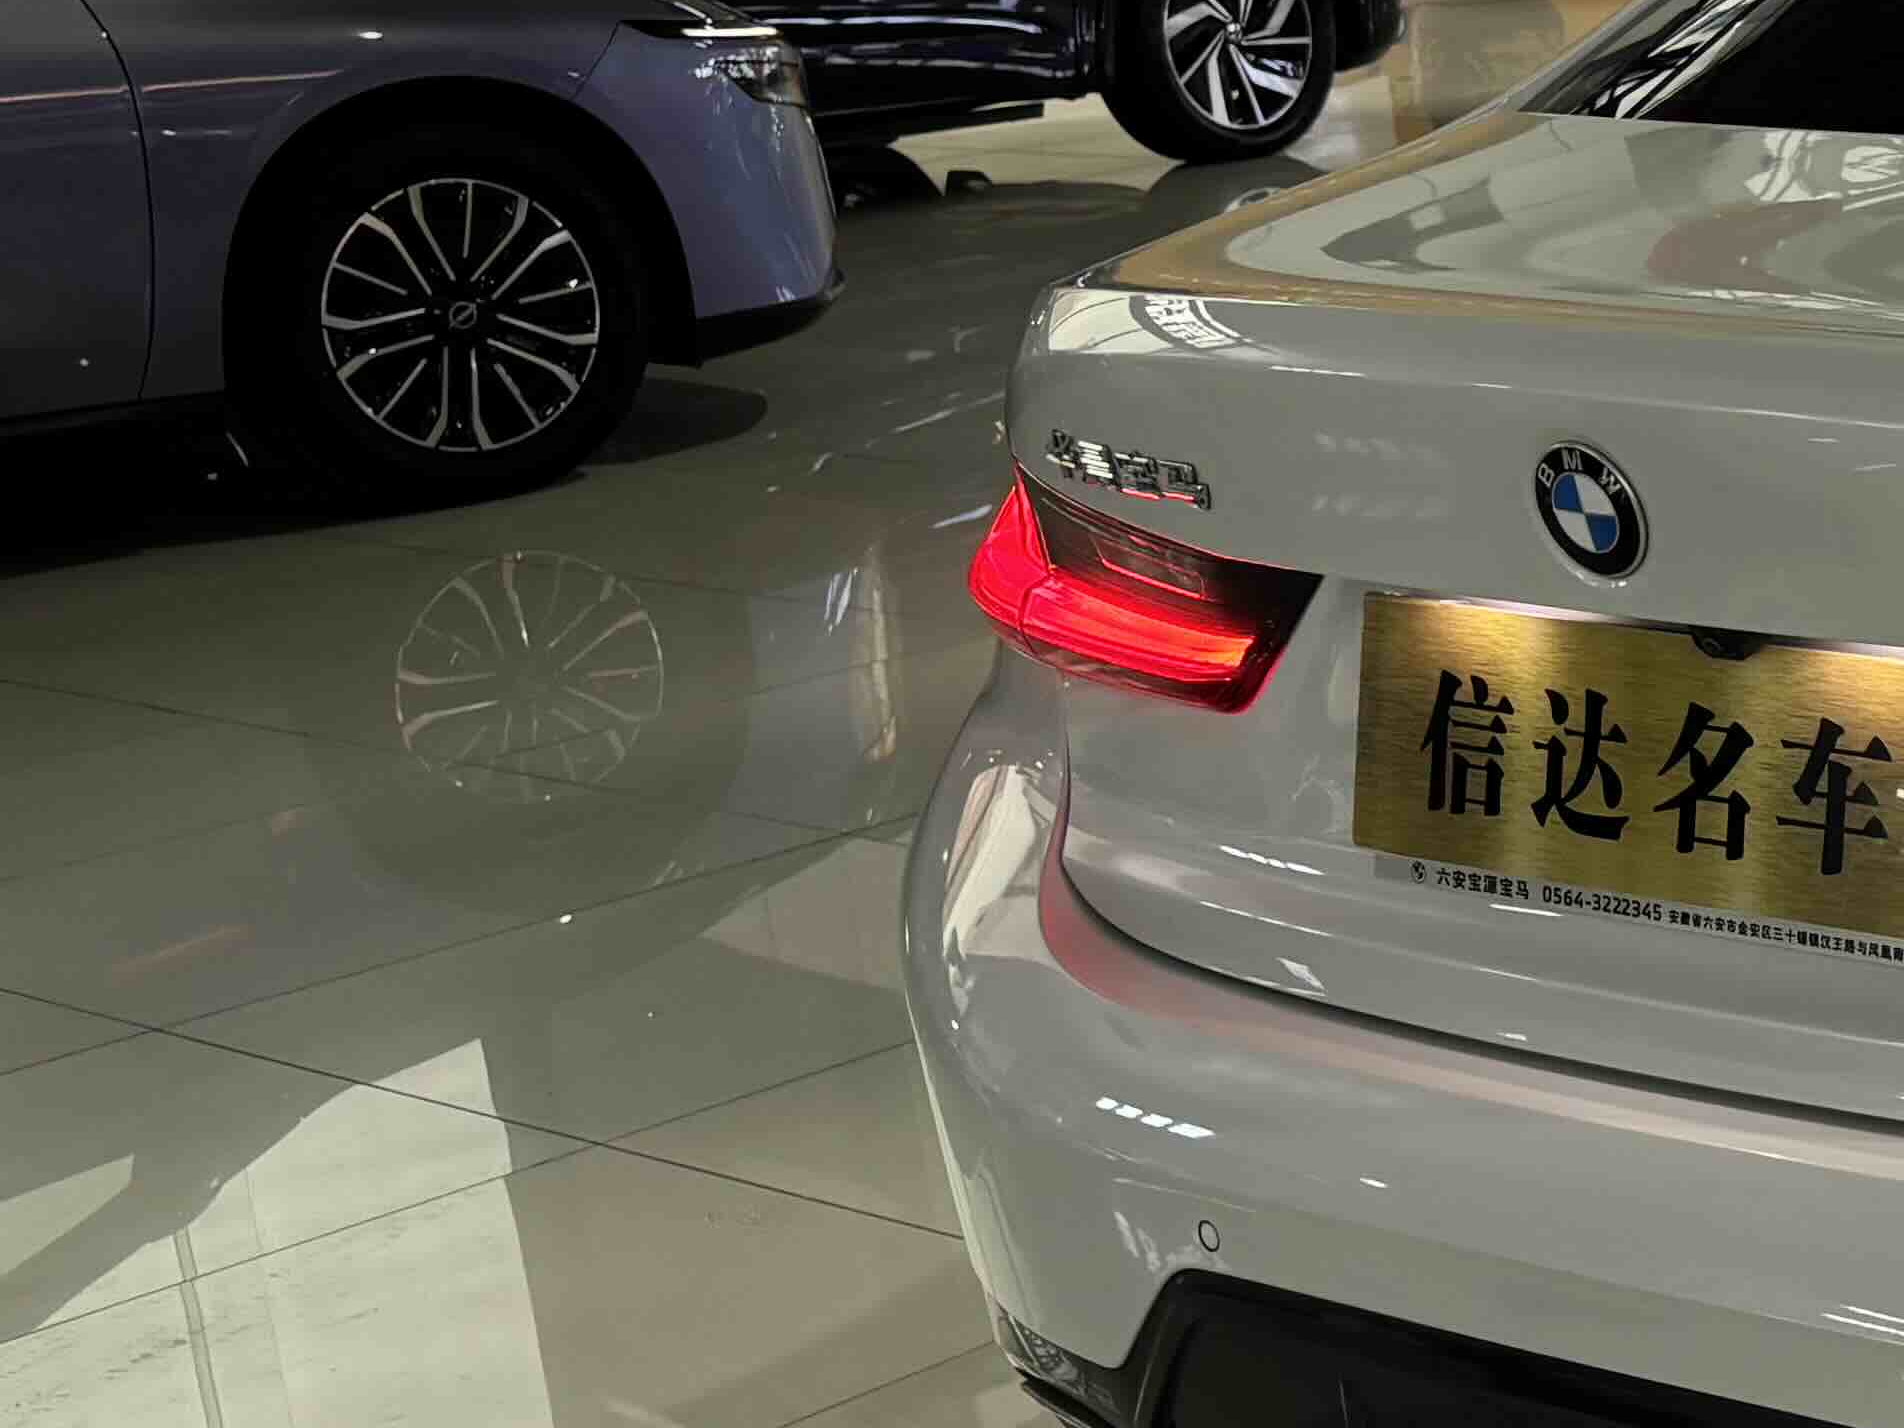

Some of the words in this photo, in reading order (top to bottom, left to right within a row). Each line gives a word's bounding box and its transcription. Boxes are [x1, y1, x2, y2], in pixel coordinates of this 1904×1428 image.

[1420, 669, 1893, 875] 信达名车
[1435, 866, 1530, 900] 六安宝源宝马
[1541, 884, 1663, 922] 0564-3222345
